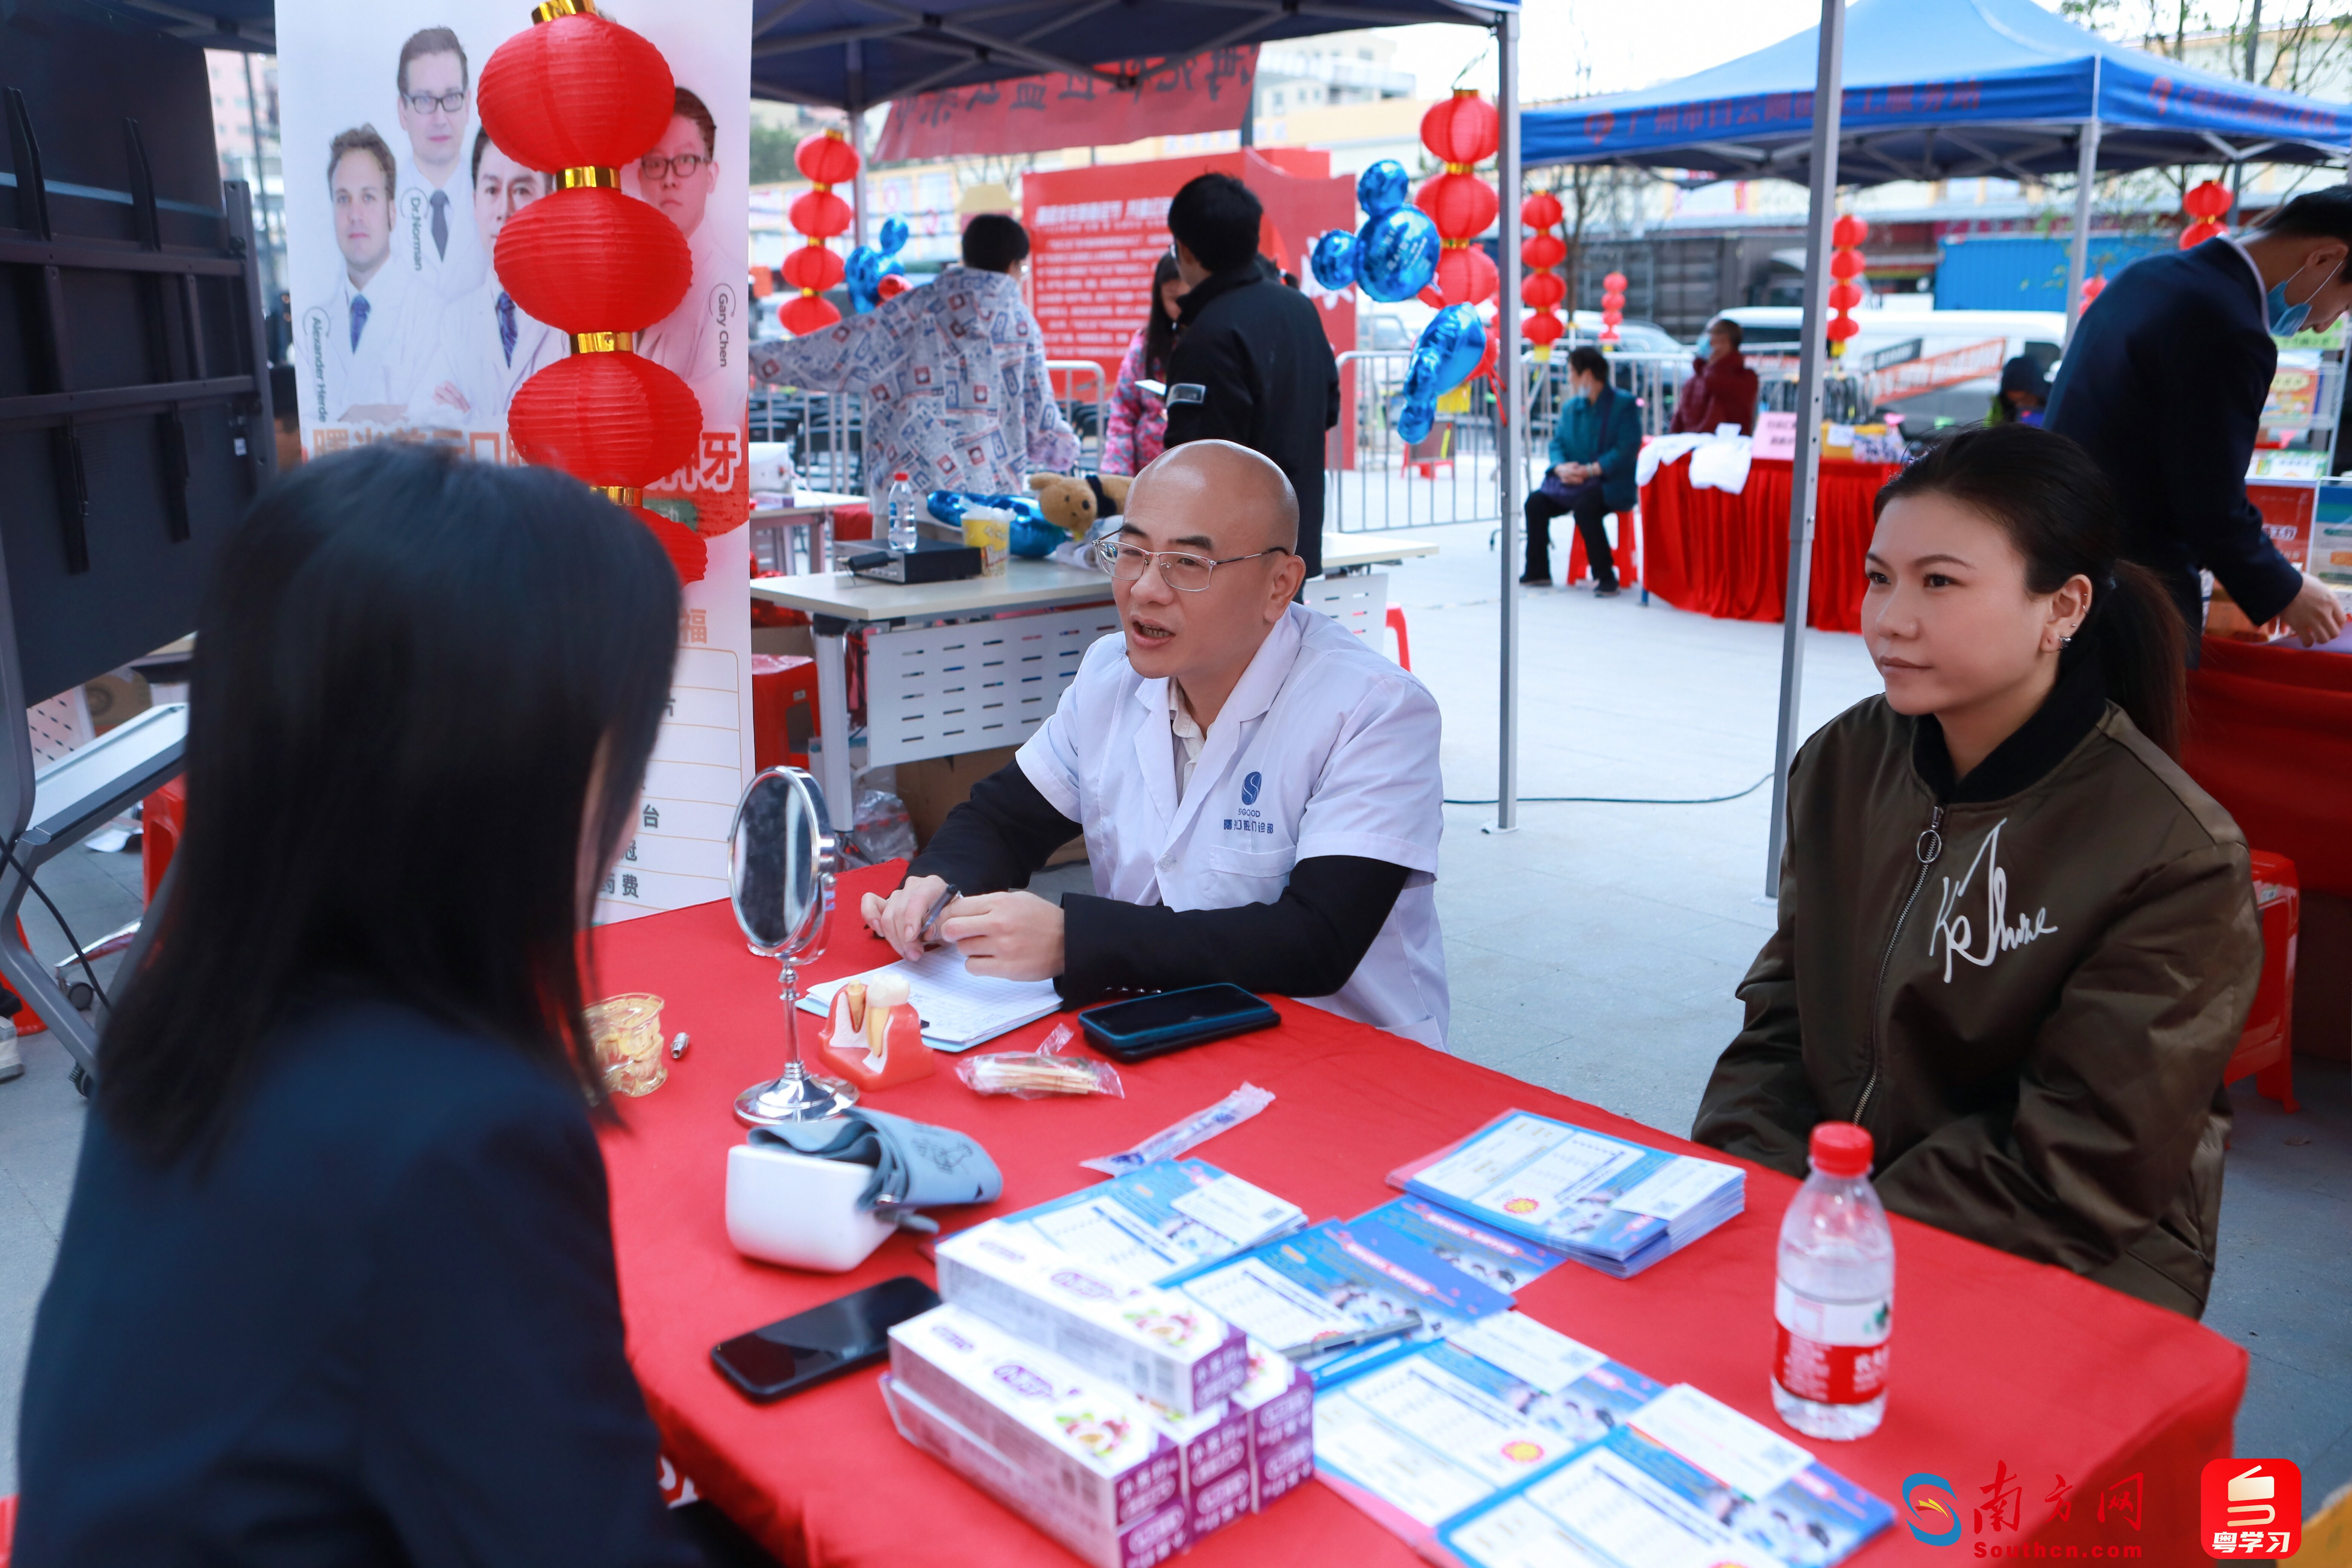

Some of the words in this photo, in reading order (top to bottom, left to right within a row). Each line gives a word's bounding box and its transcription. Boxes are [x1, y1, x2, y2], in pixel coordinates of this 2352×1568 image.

[717, 293, 728, 326] Gary
[311, 316, 326, 381] Alexander
[719, 330, 729, 367] Chen
